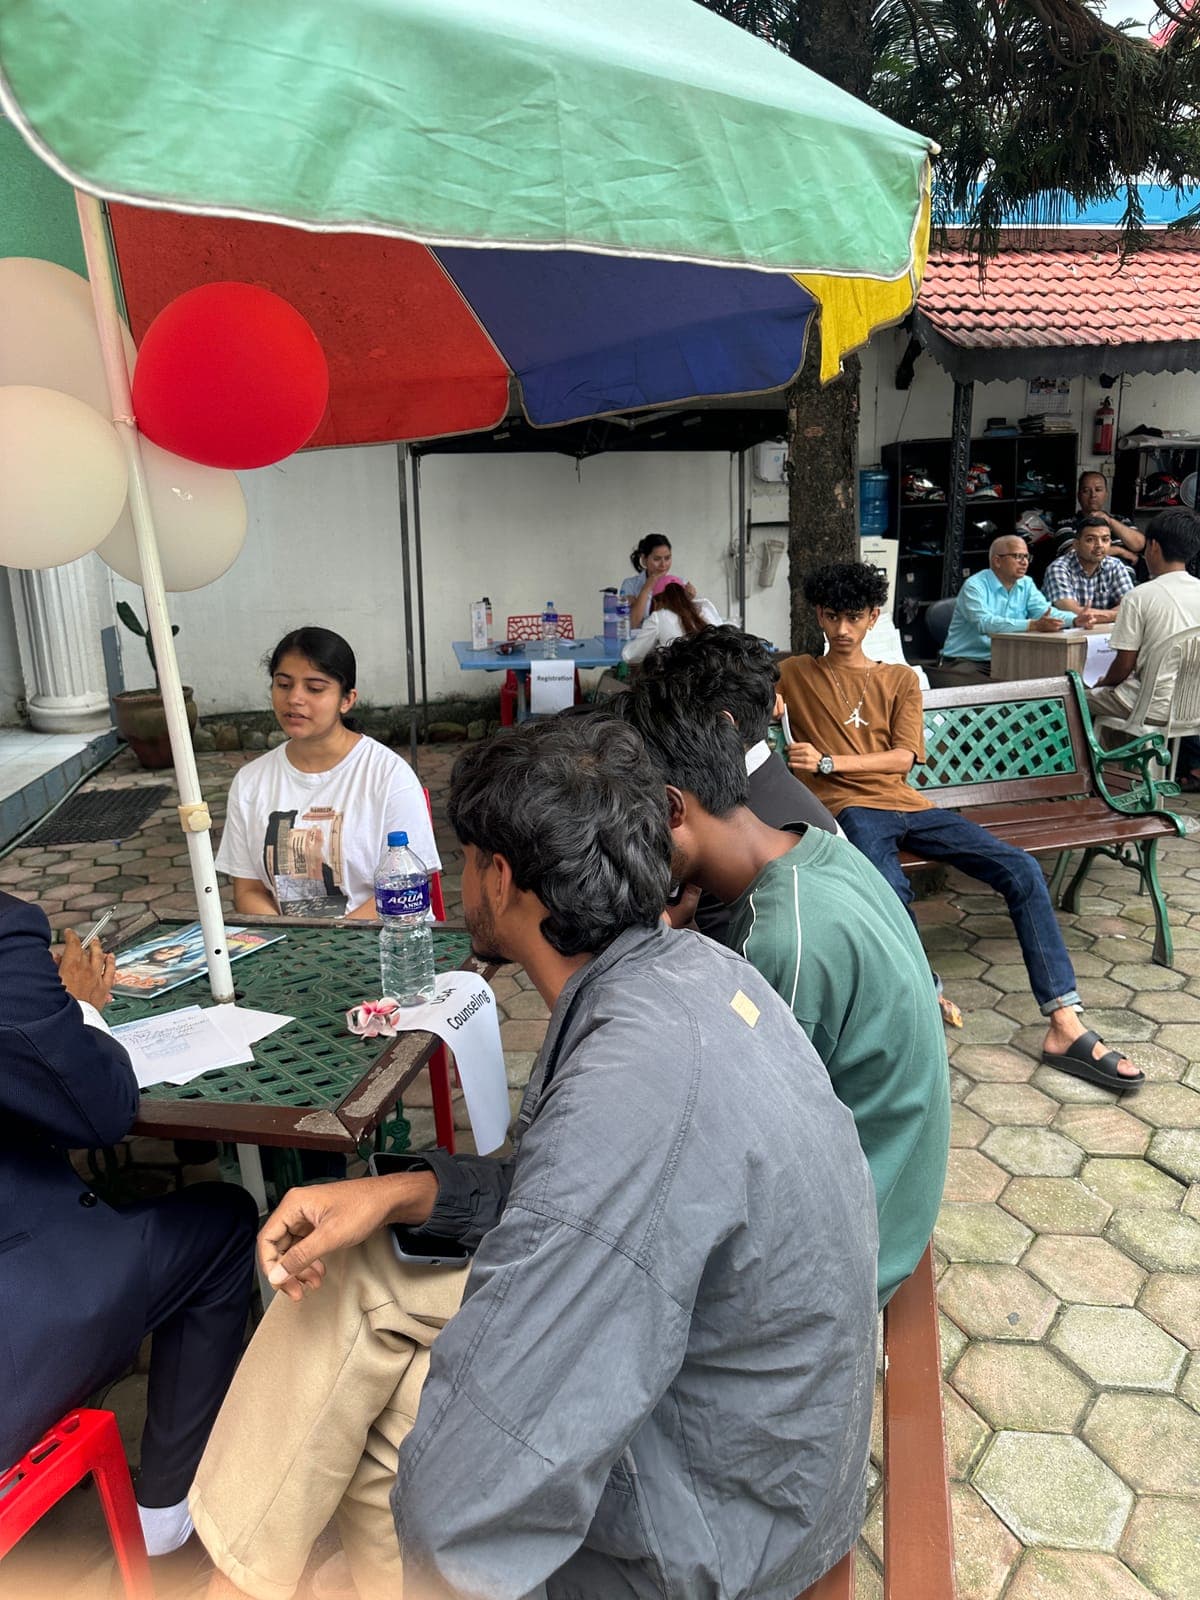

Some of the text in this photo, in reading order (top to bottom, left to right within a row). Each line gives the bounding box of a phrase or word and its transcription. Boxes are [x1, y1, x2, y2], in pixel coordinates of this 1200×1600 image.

[387, 892, 424, 905] AQUA
[430, 988, 456, 1005] USA
[446, 989, 491, 1030] Counseling
